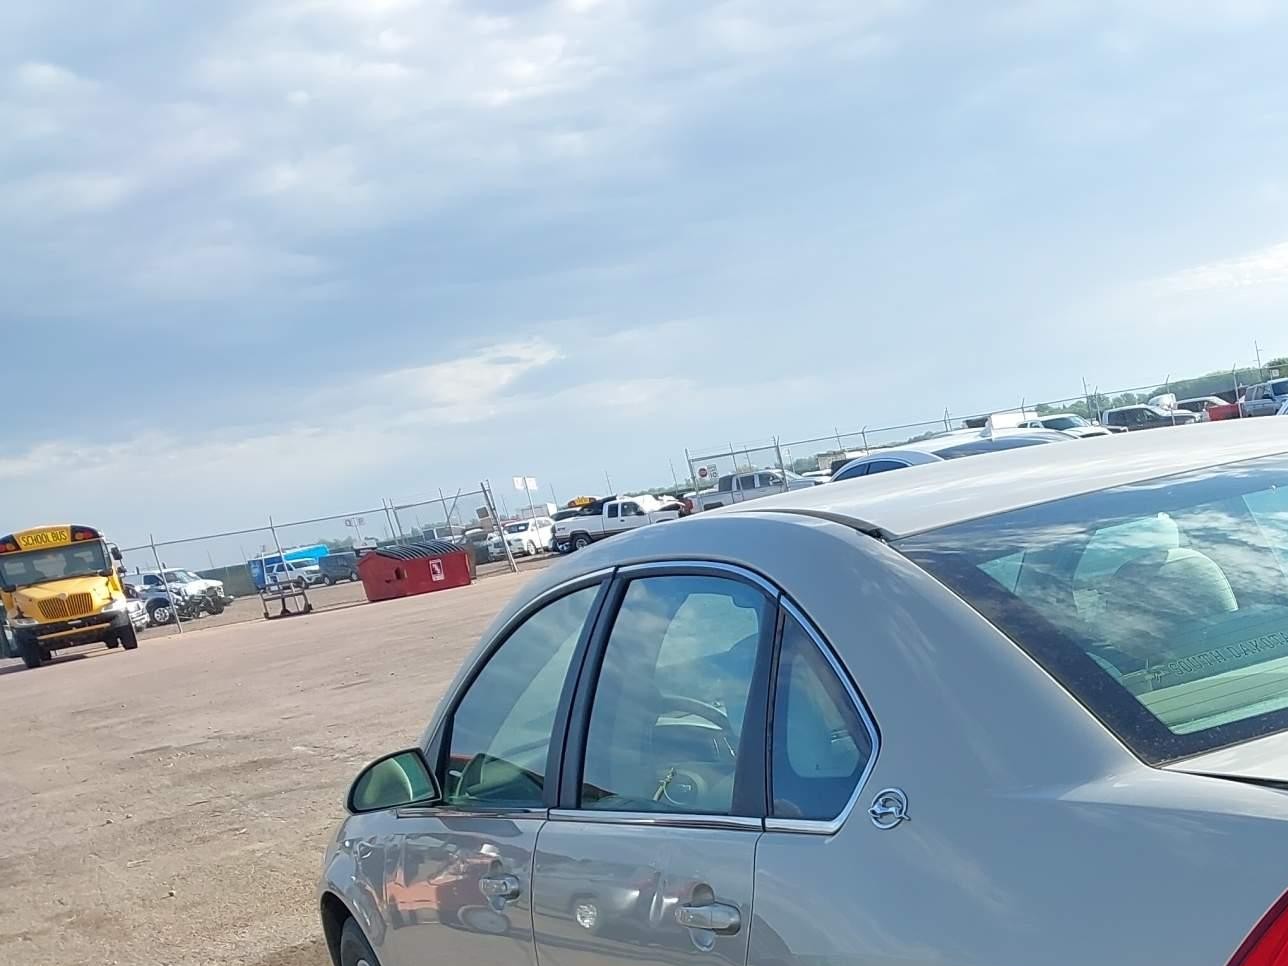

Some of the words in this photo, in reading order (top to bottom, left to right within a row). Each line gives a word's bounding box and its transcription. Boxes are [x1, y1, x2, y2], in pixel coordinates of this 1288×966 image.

[21, 533, 51, 547] SCHOOL
[51, 530, 68, 543] BUS
[1168, 650, 1226, 676] SOUTH
